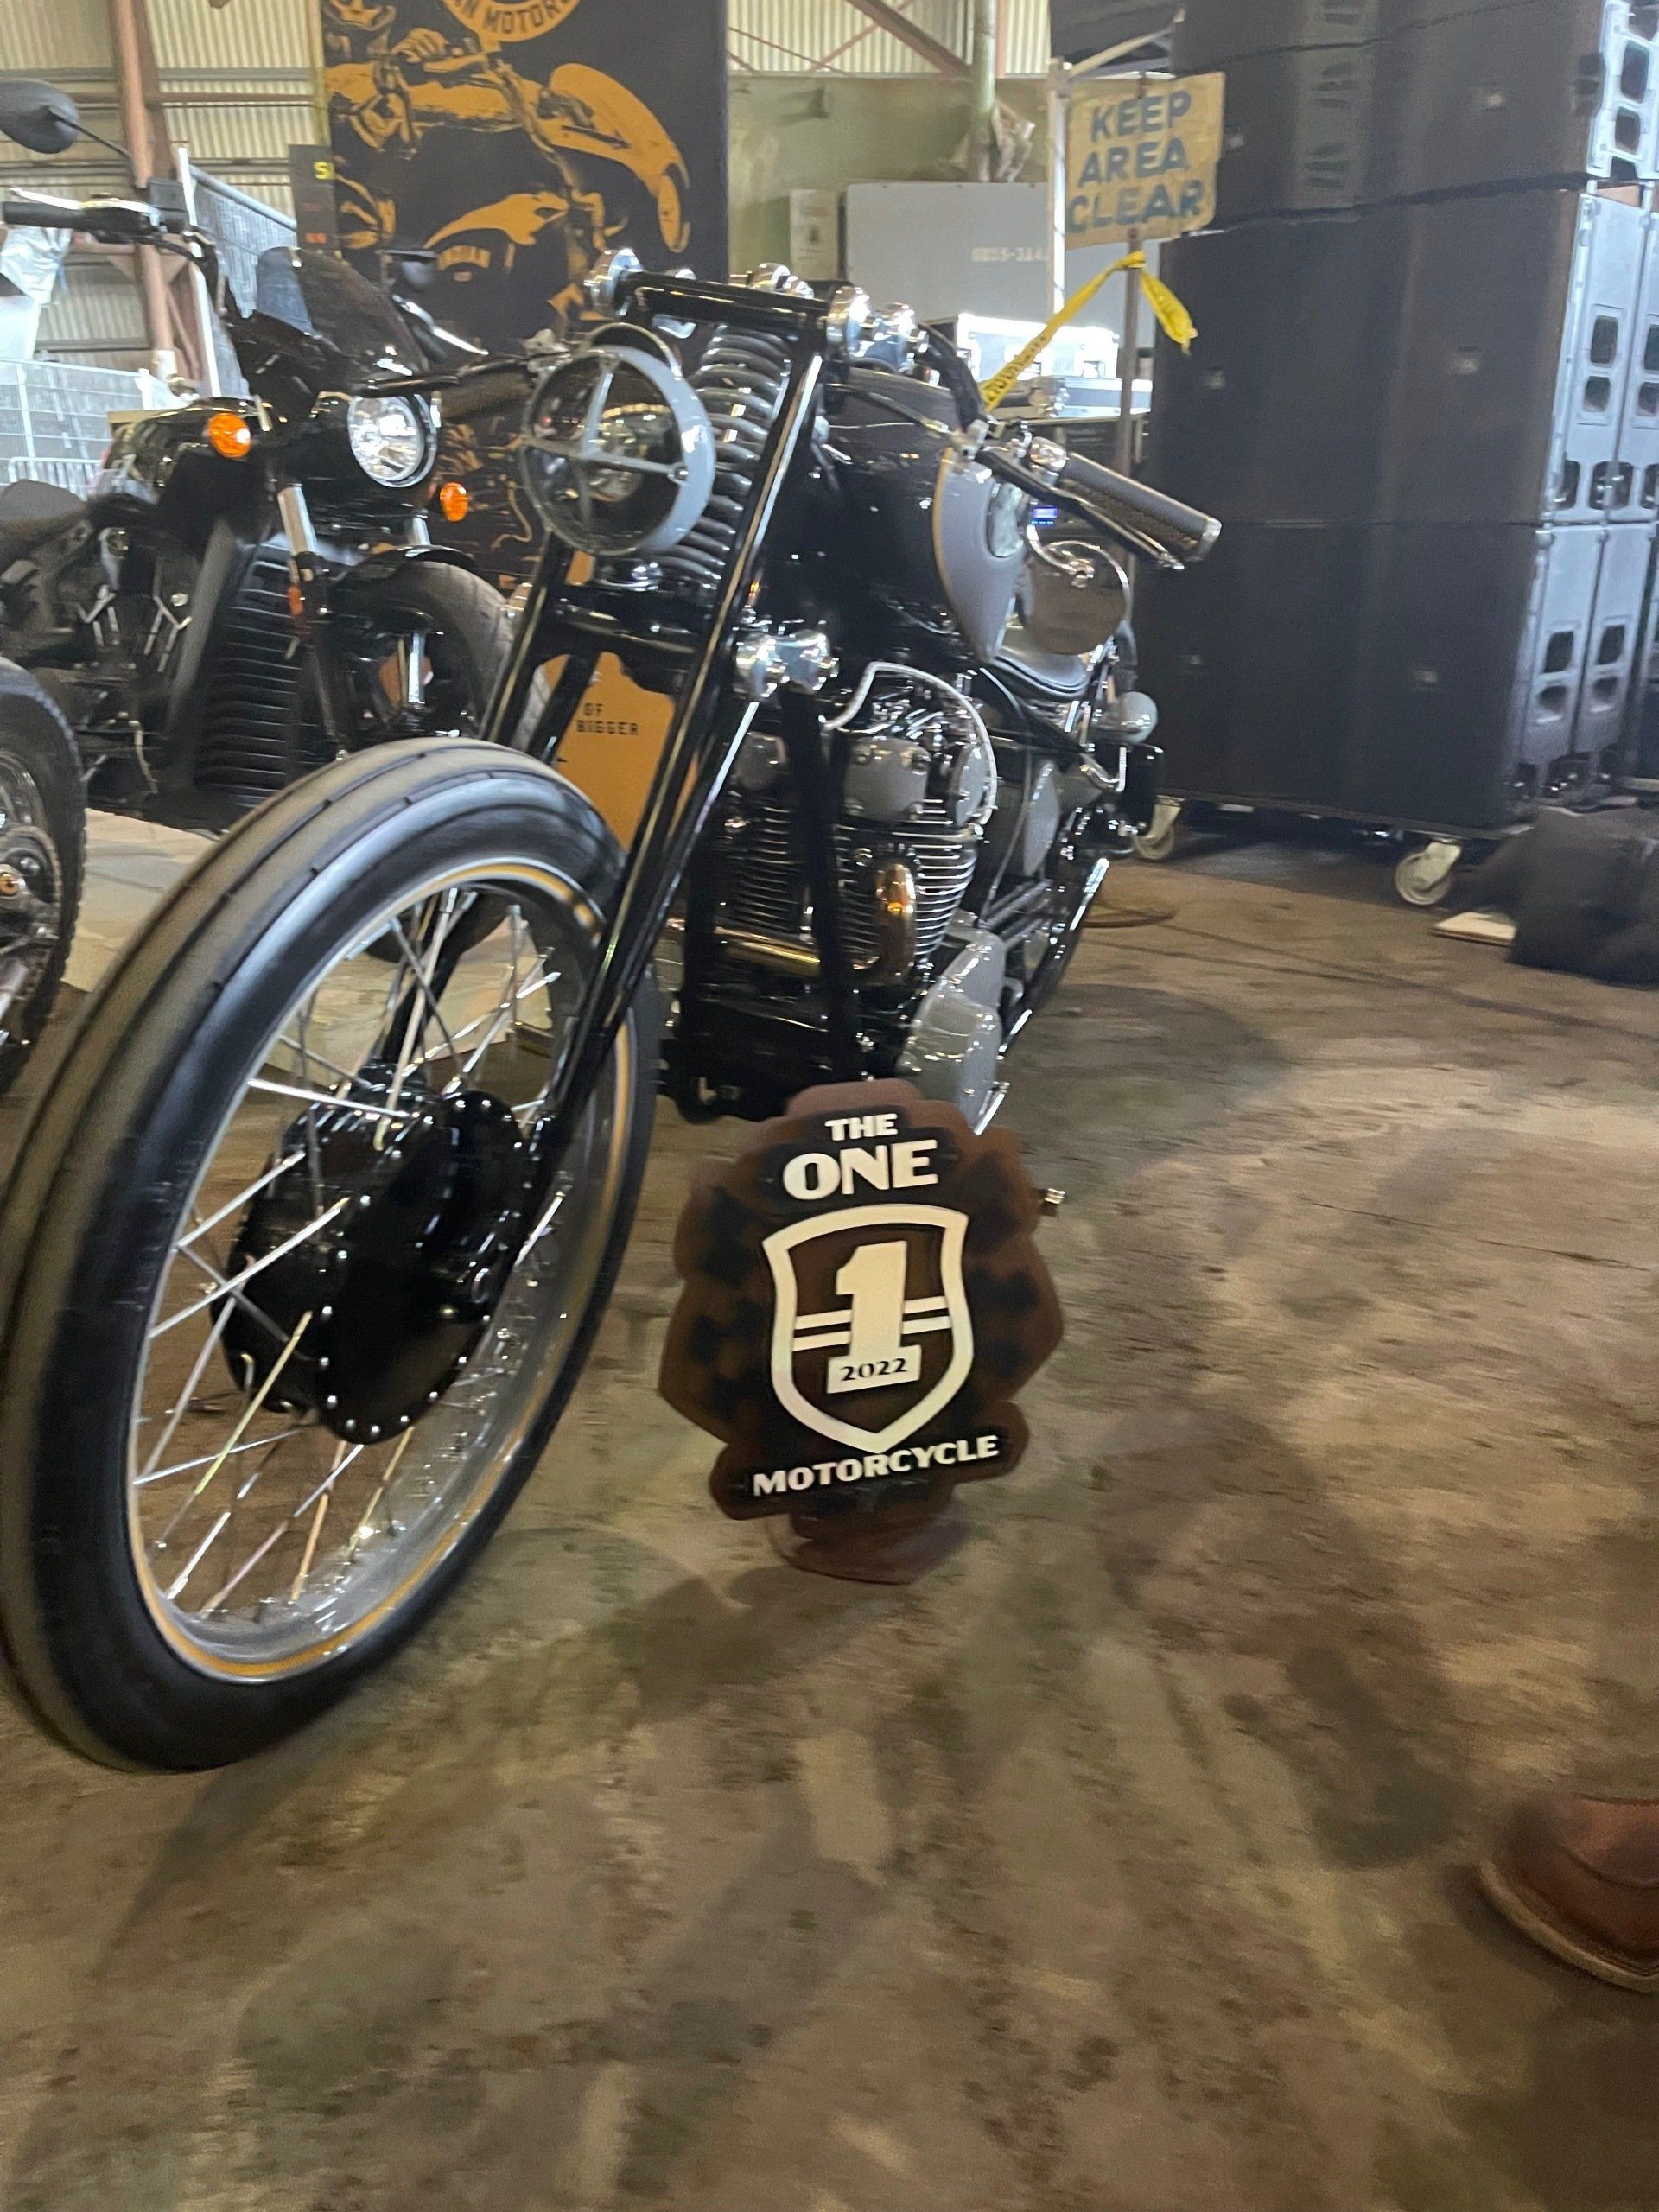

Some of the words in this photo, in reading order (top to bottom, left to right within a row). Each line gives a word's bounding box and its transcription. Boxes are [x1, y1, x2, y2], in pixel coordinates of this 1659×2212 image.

[482, 0, 569, 34] MOTOR
[1090, 91, 1192, 143] KEEP
[1079, 137, 1189, 188] AREA
[1067, 179, 1204, 233] CLEAR
[825, 1113, 898, 1141] THE
[783, 1139, 938, 1200] ONE
[827, 1240, 922, 1394] 1
[841, 1357, 907, 1382] 2022
[753, 1434, 1000, 1497] MOTORCYCLE
